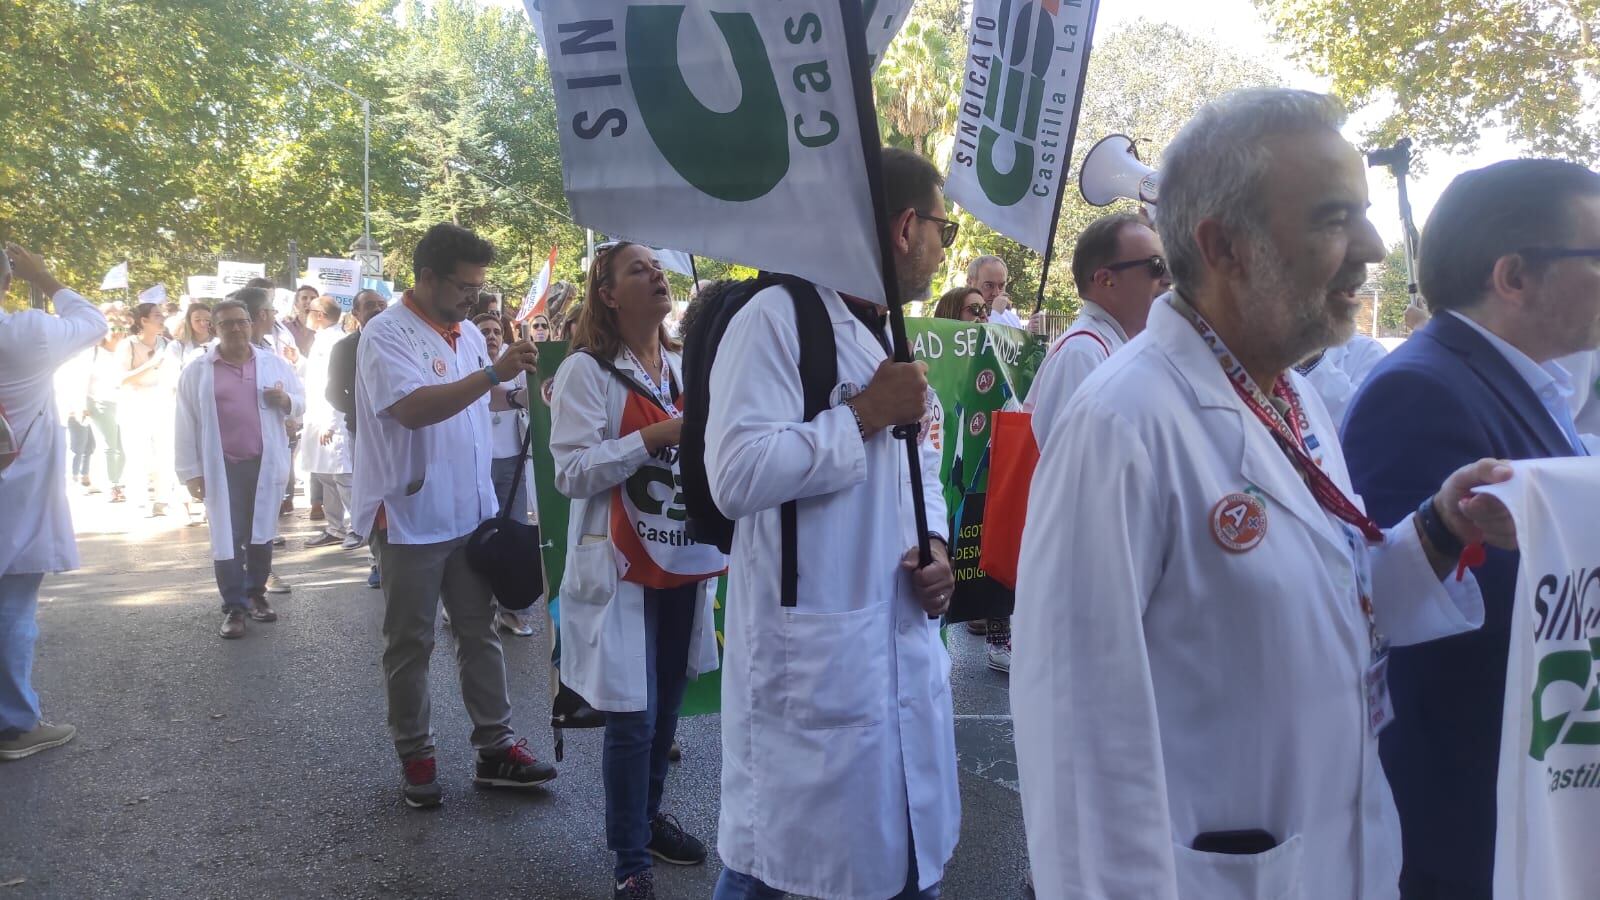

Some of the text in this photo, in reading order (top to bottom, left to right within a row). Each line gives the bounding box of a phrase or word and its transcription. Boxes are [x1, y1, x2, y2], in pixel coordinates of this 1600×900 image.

[956, 16, 996, 167] SINDICATO
[1033, 92, 1066, 197] Castilla
[1056, 24, 1078, 53] La
[954, 328, 977, 357] SE
